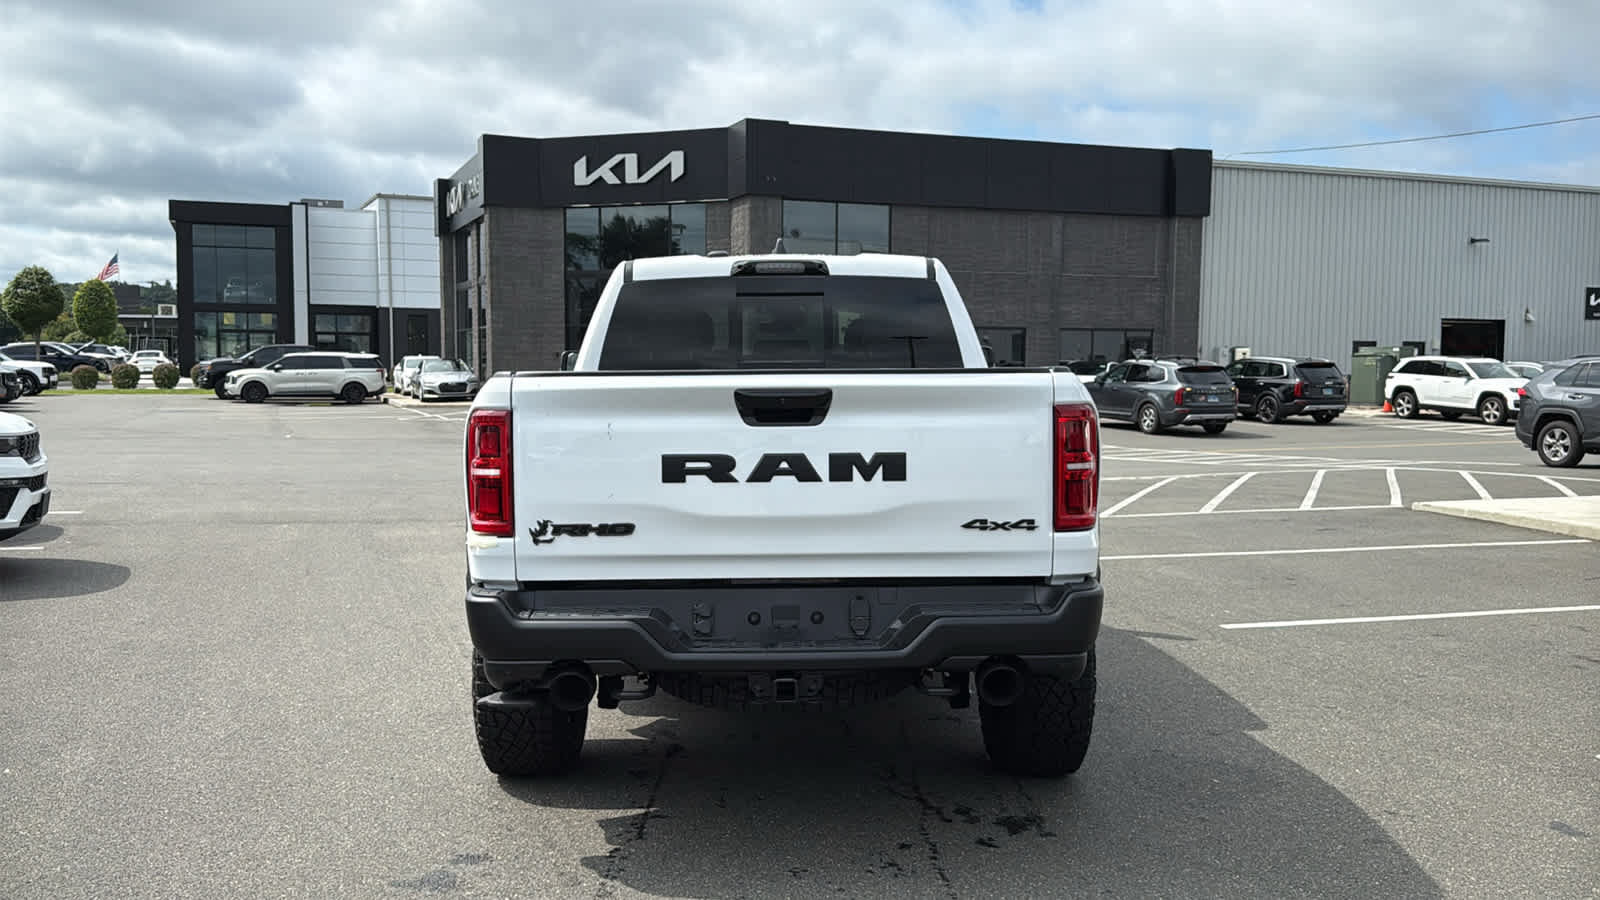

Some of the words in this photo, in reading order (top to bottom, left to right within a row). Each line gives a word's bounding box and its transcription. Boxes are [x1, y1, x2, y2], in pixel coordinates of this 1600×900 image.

[574, 149, 684, 186] KIA
[661, 452, 907, 484] RAM
[960, 518, 1040, 532] 4x4
